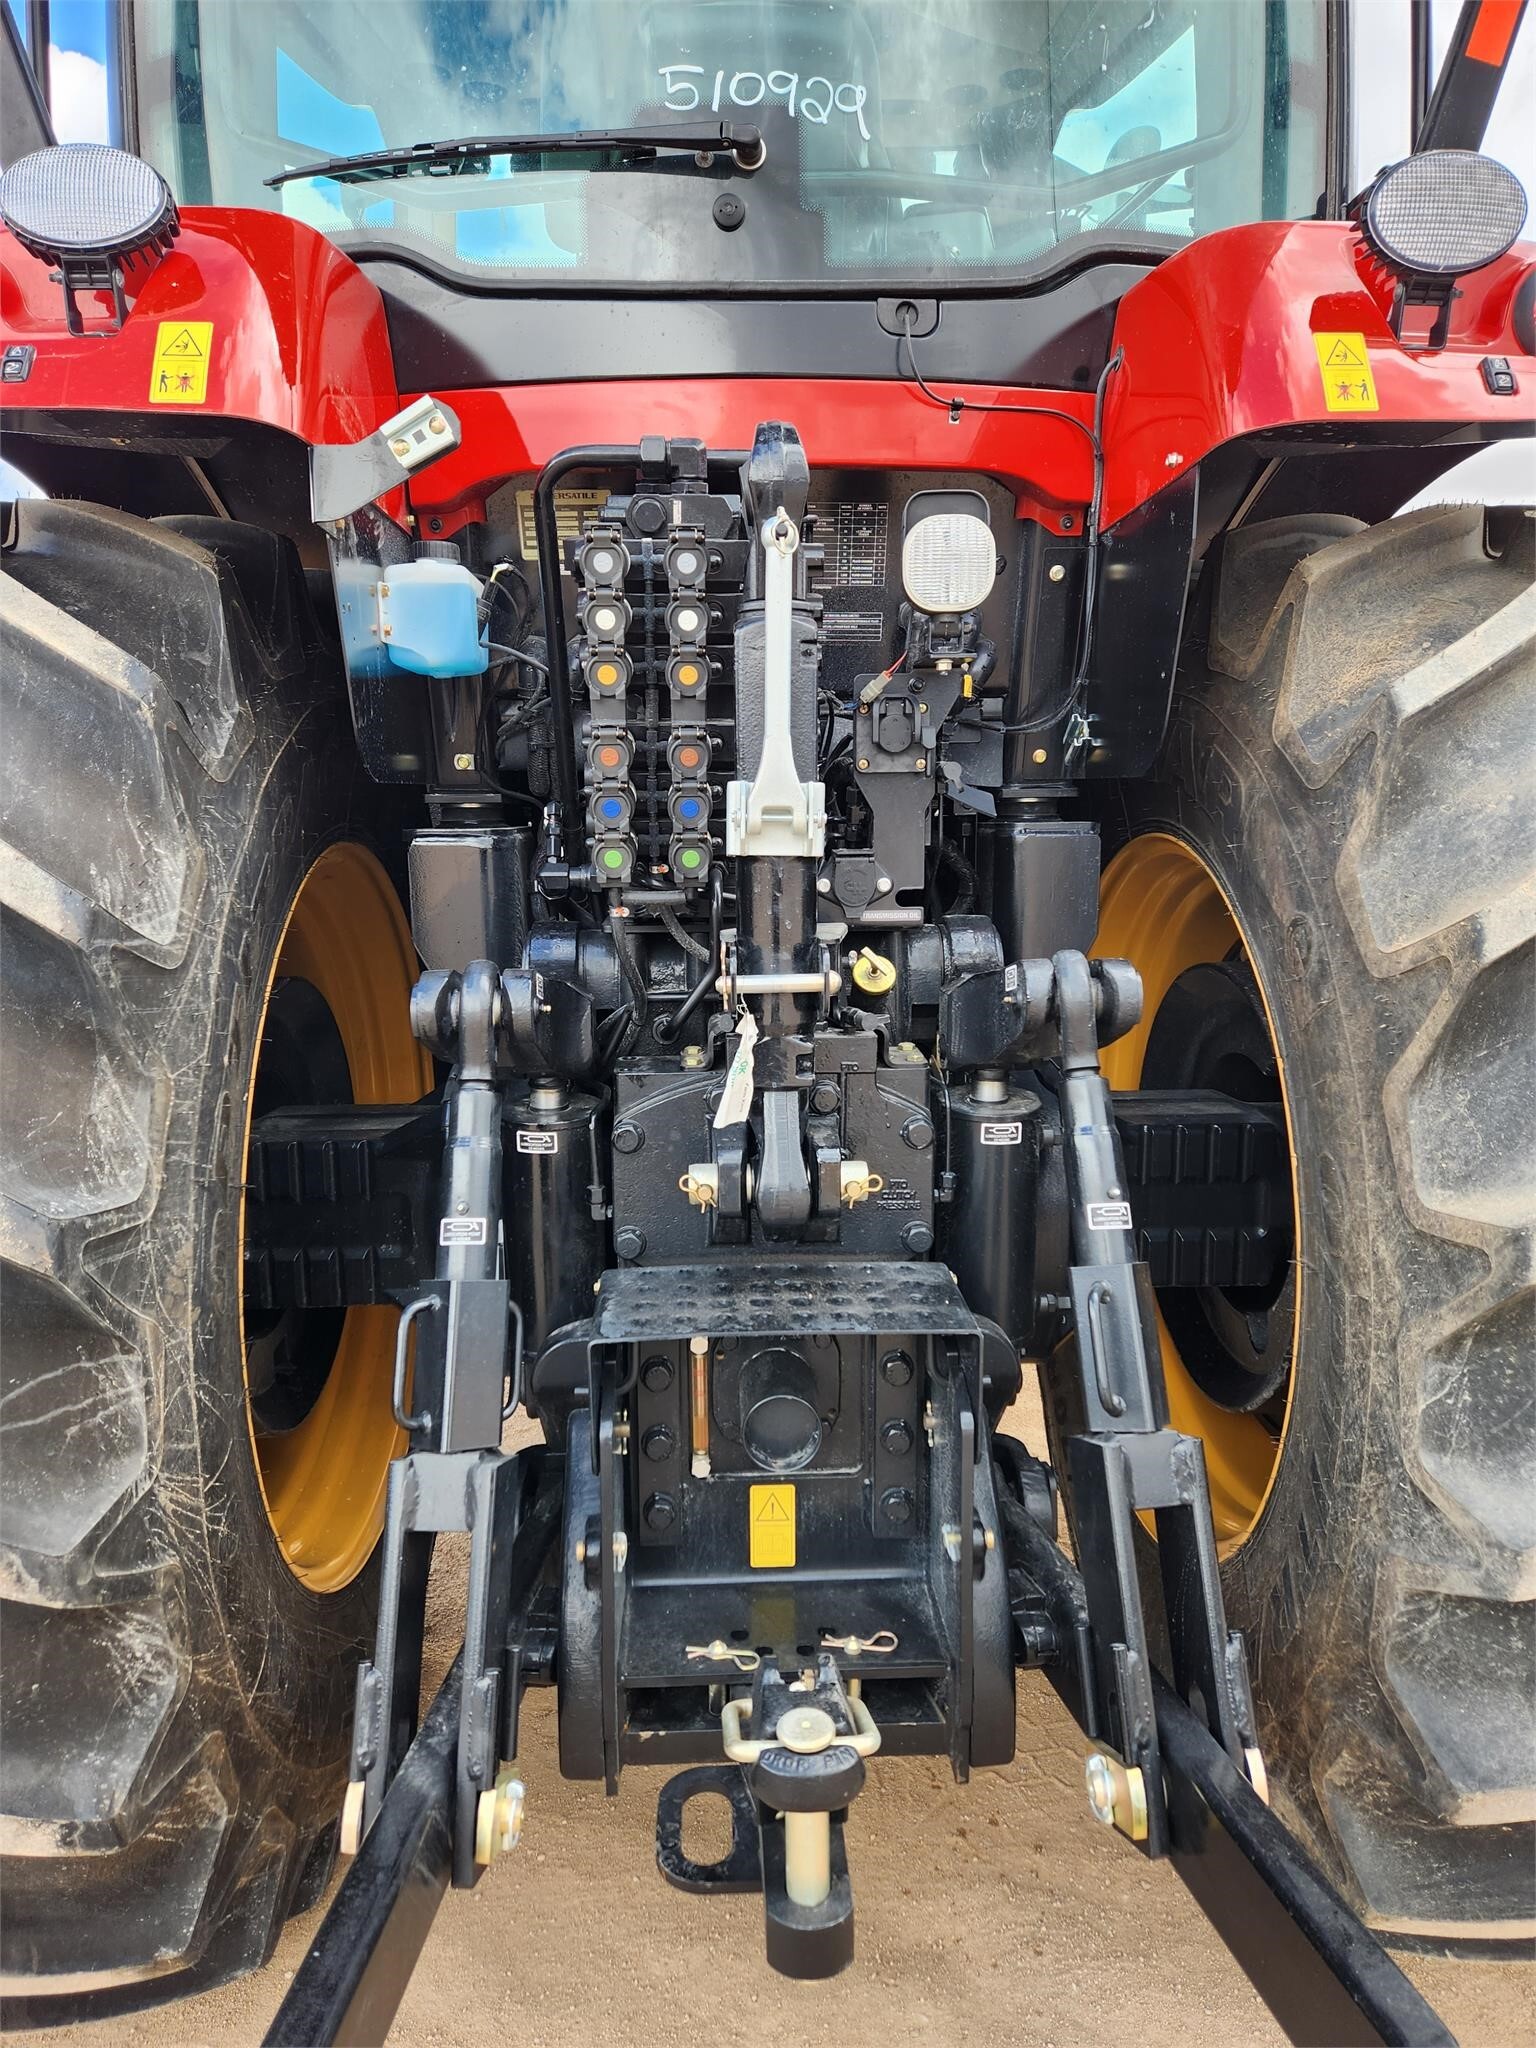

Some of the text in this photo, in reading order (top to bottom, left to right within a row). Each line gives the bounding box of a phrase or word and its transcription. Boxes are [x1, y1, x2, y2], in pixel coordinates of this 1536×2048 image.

[658, 65, 871, 141] 510929
[863, 911, 921, 919] TRANSMISSION OIL
[841, 1061, 859, 1071] PTO
[889, 1178, 908, 1189] PTO
[881, 1189, 918, 1199] CLUTCH
[876, 1200, 921, 1210] PRESSURE
[762, 1750, 809, 1771] DROP
